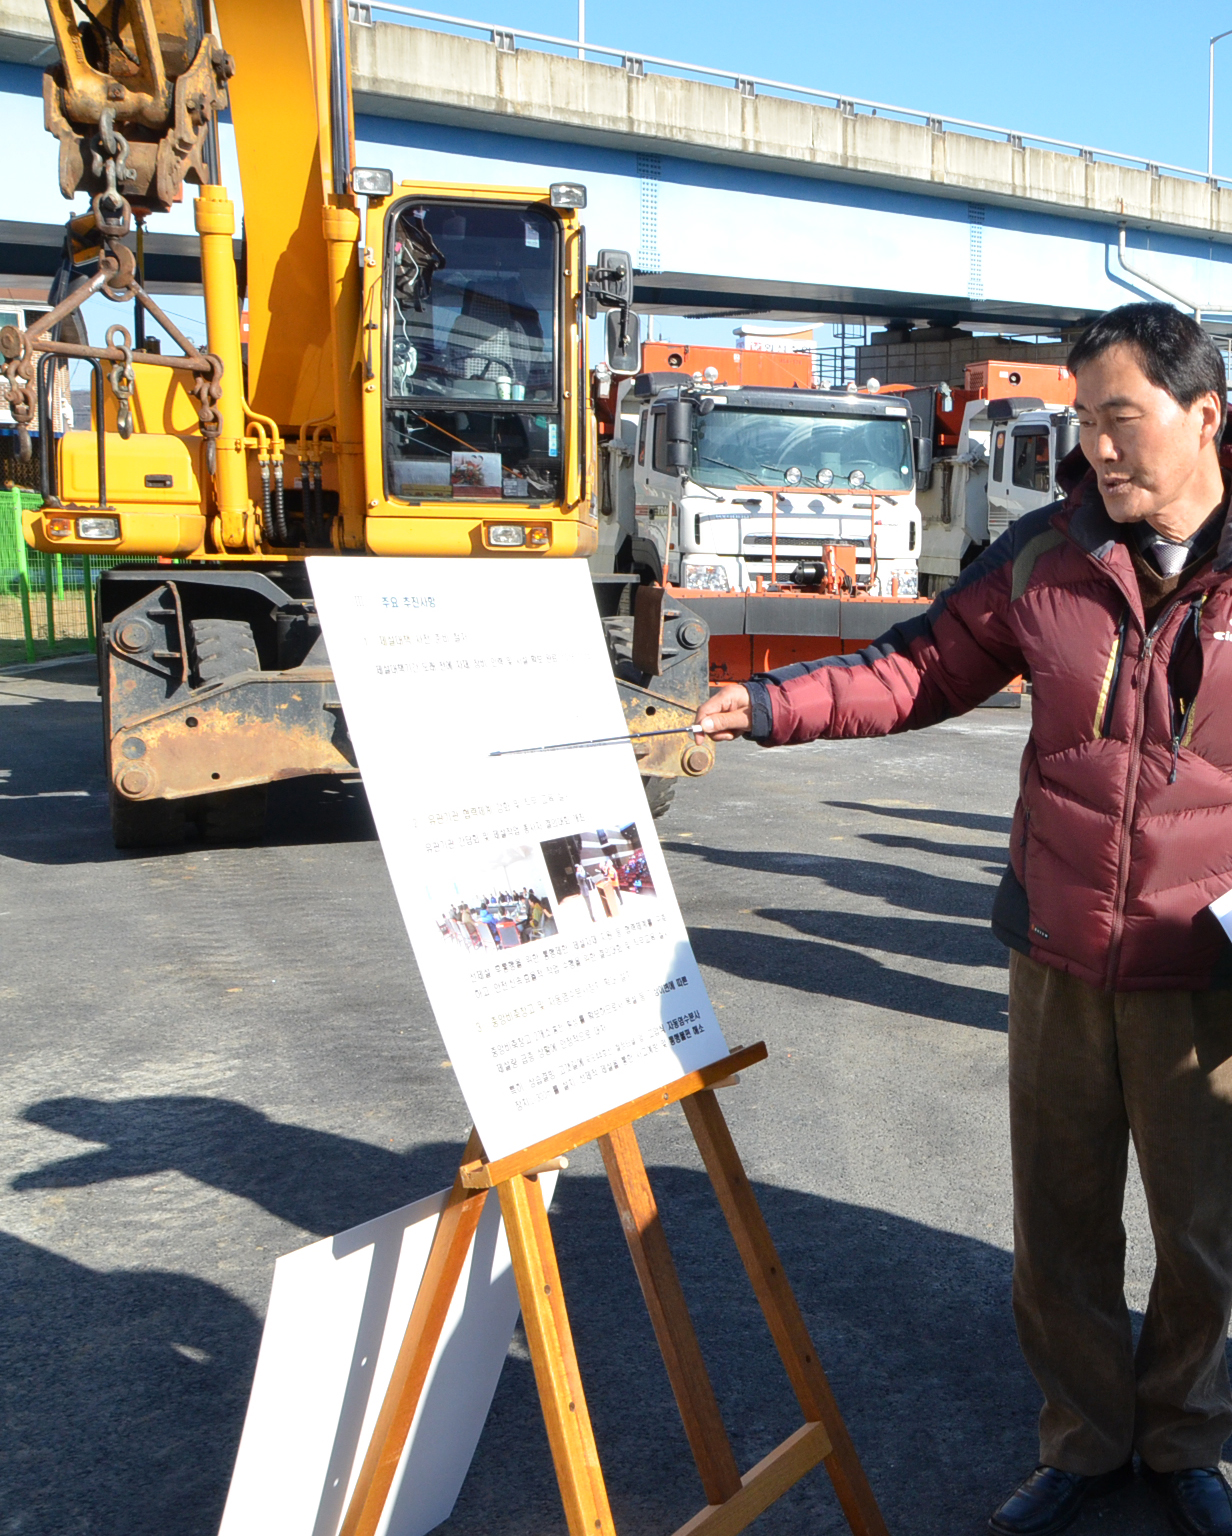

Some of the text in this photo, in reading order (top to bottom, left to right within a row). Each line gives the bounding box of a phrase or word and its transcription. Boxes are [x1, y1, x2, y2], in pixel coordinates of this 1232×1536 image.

[380, 596, 399, 608] 주요
[378, 634, 411, 646] 제설대책
[374, 662, 419, 675] 제설대책기간
[427, 809, 459, 825] 유관기관
[424, 838, 454, 853] 유관기관
[492, 826, 520, 839] 제설작업
[490, 1003, 534, 1028] 중앙비축창고
[490, 1033, 531, 1058] 중앙비축창고
[675, 975, 688, 987] 따른
[666, 1009, 700, 1030] 자동염수분사
[691, 1023, 705, 1035] 해소
